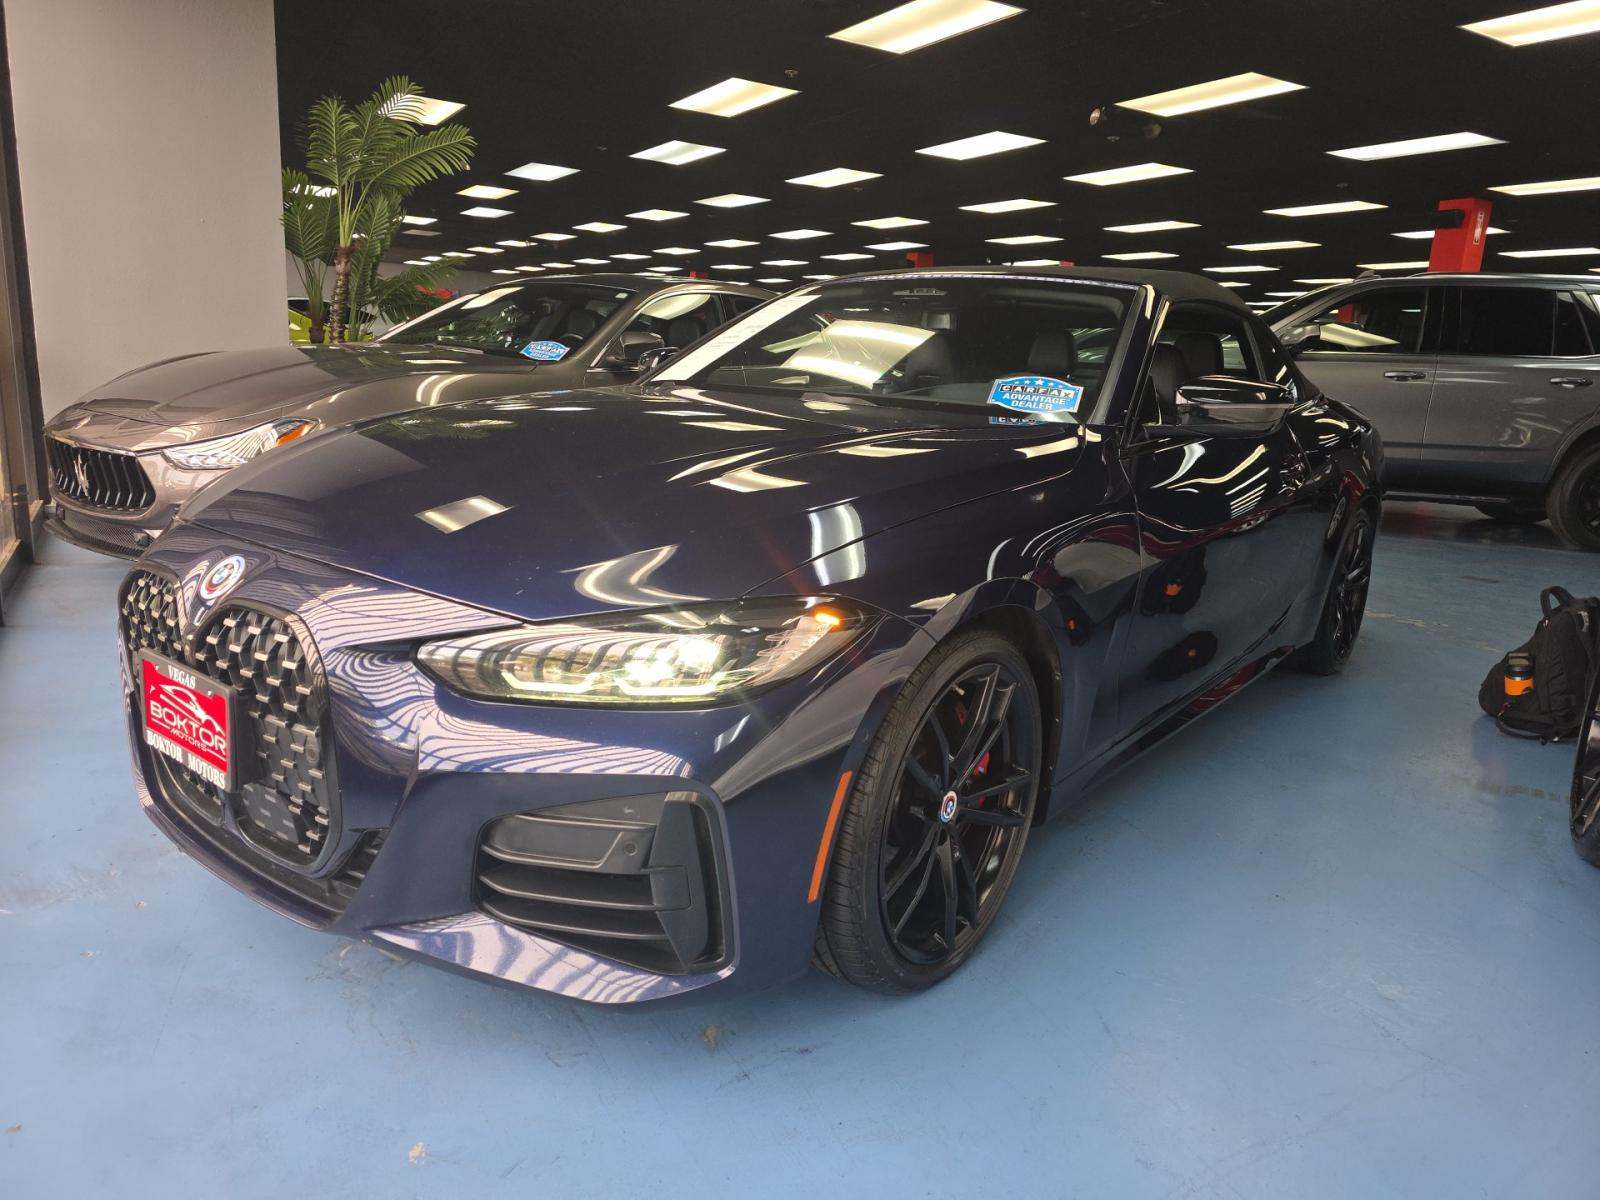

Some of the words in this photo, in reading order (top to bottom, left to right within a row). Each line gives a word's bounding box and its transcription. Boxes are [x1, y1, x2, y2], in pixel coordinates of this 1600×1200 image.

[1001, 384, 1075, 398] CARFAX
[1002, 393, 1066, 405] ADVANTAGE
[1011, 400, 1053, 410] DEALER
[167, 665, 196, 689] VEGAS
[150, 700, 227, 755] BOKTOR
[169, 728, 208, 752] MOTORS
[146, 730, 183, 763] BOKTOR
[187, 753, 226, 788] MOTORS
